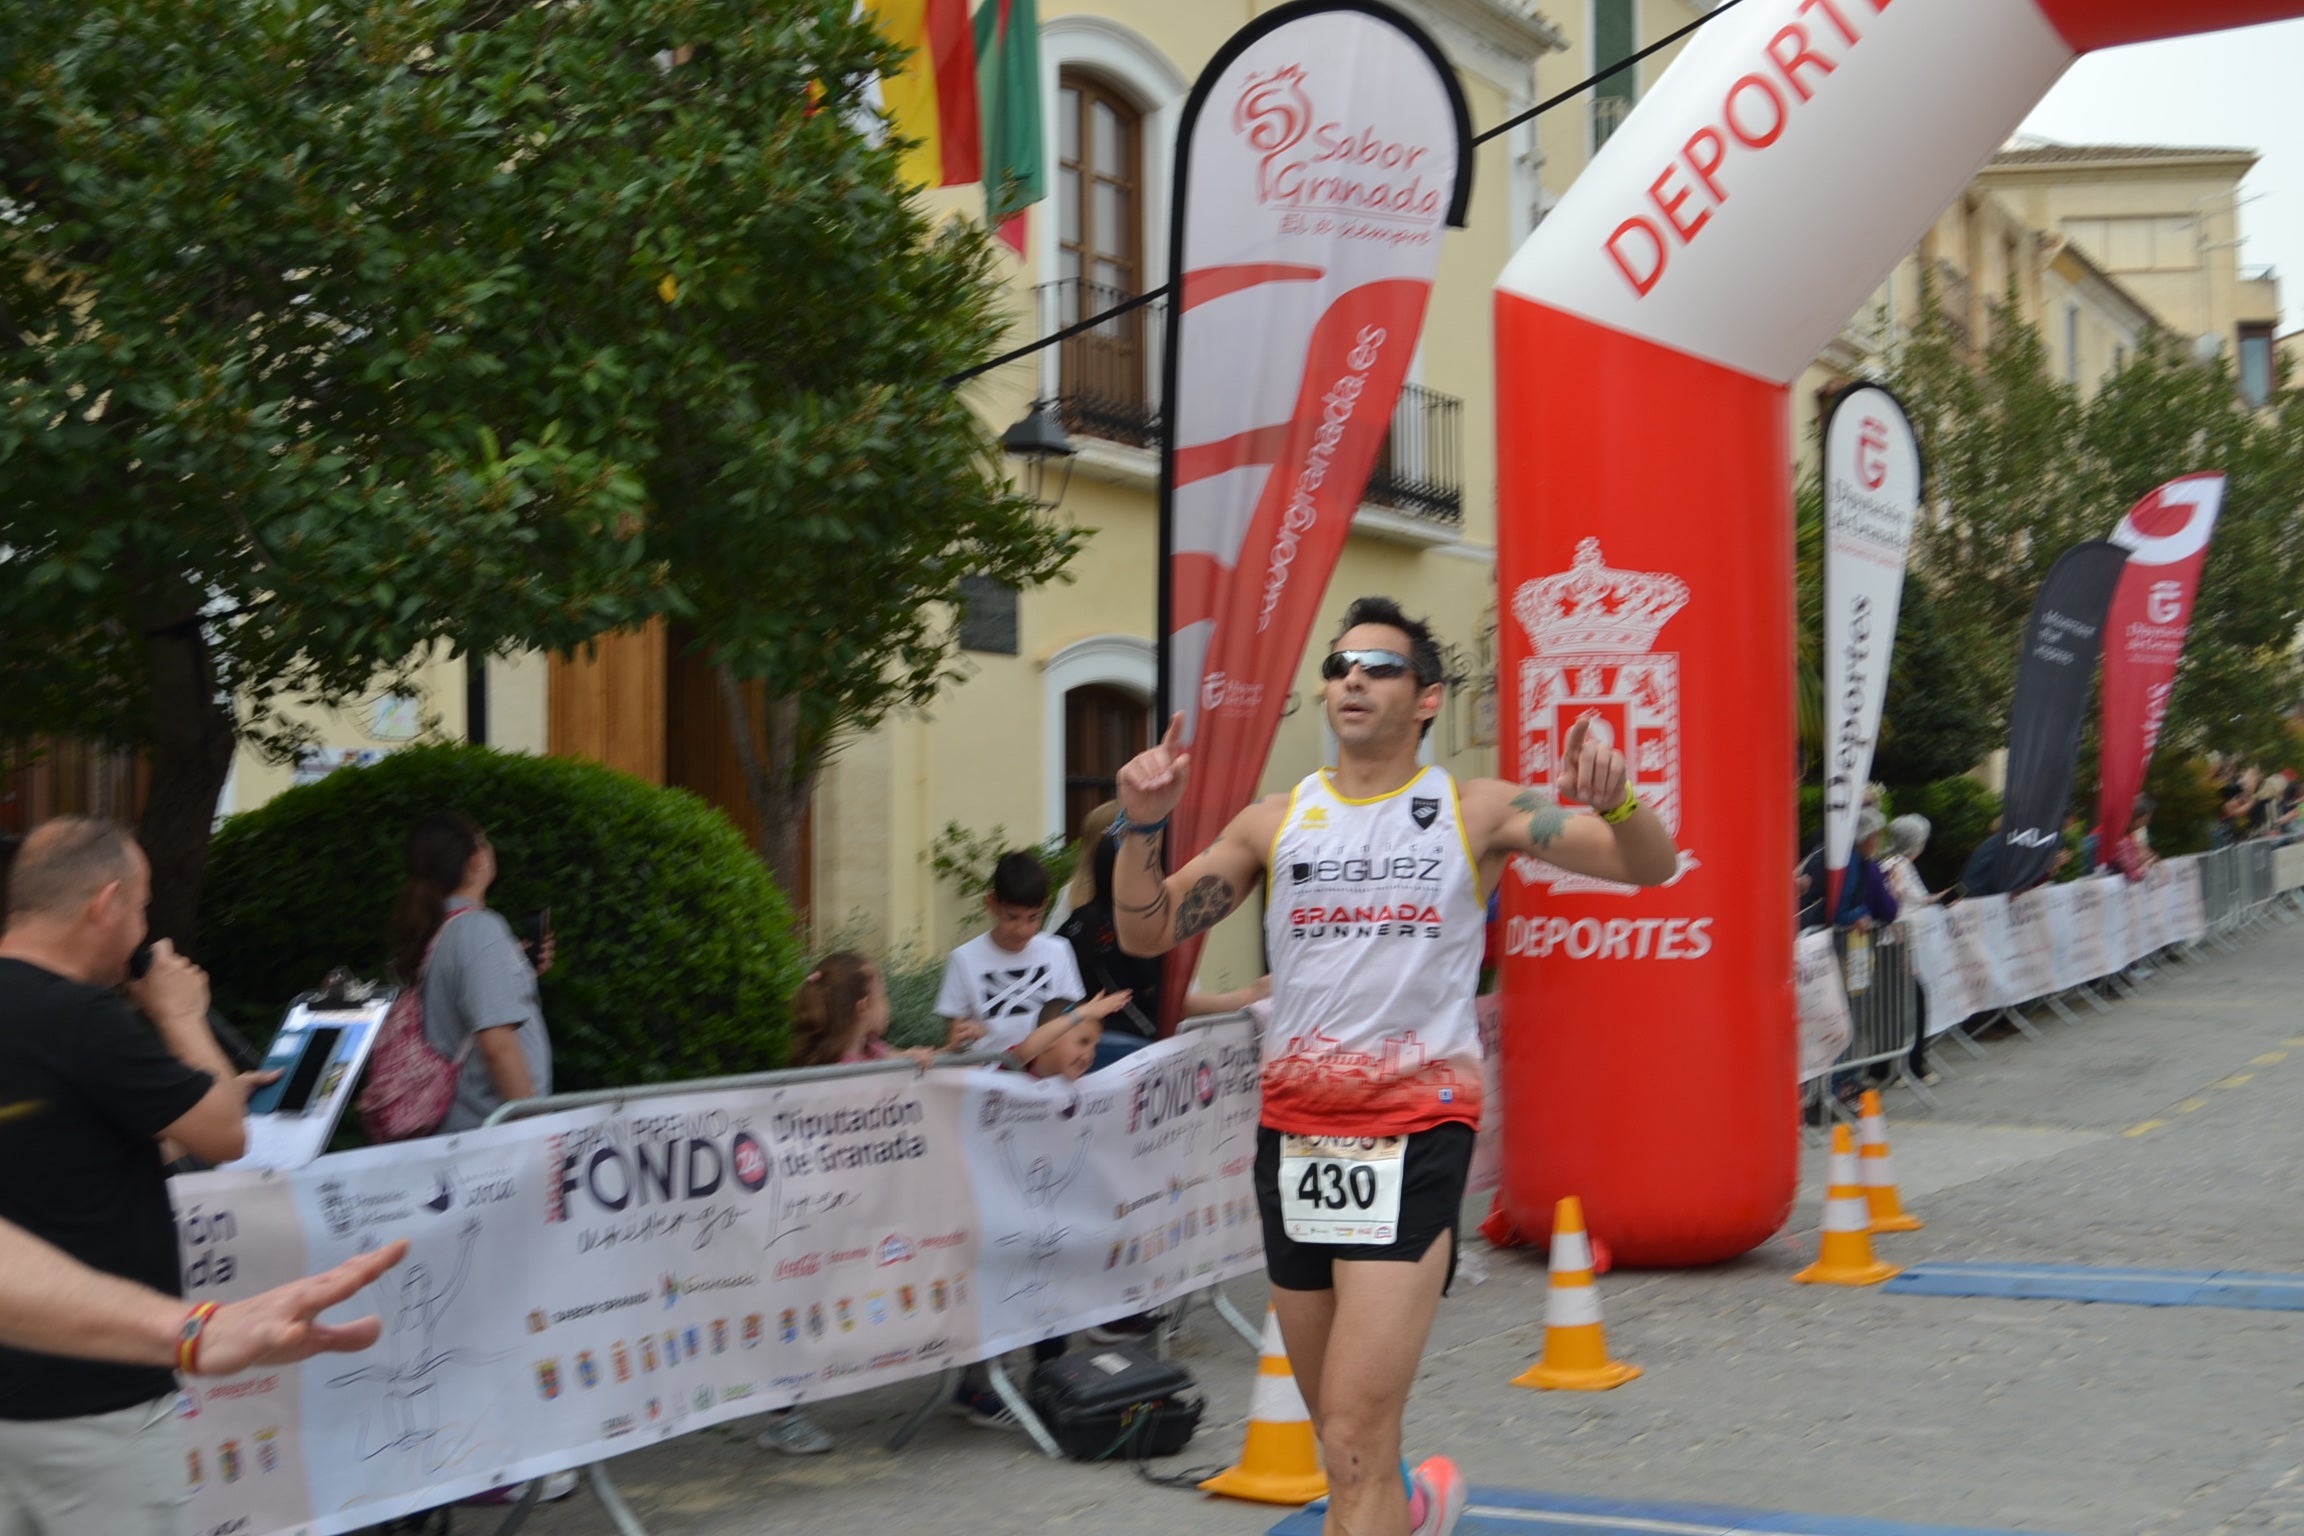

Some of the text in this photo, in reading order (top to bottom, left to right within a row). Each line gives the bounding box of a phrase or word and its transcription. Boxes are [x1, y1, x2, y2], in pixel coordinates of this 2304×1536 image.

[1310, 122, 1430, 172] Sabor
[1603, 0, 1893, 299] DEPORT
[1274, 160, 1441, 215] Granada
[1290, 903, 1444, 926] GRANADA
[1291, 923, 1442, 939] RUNNERS
[1505, 914, 1714, 960] DEPORTES
[772, 1094, 924, 1144] Diputación
[558, 1131, 771, 1222] FONDO
[816, 1131, 929, 1173] Granada
[1298, 1162, 1376, 1210] 430
